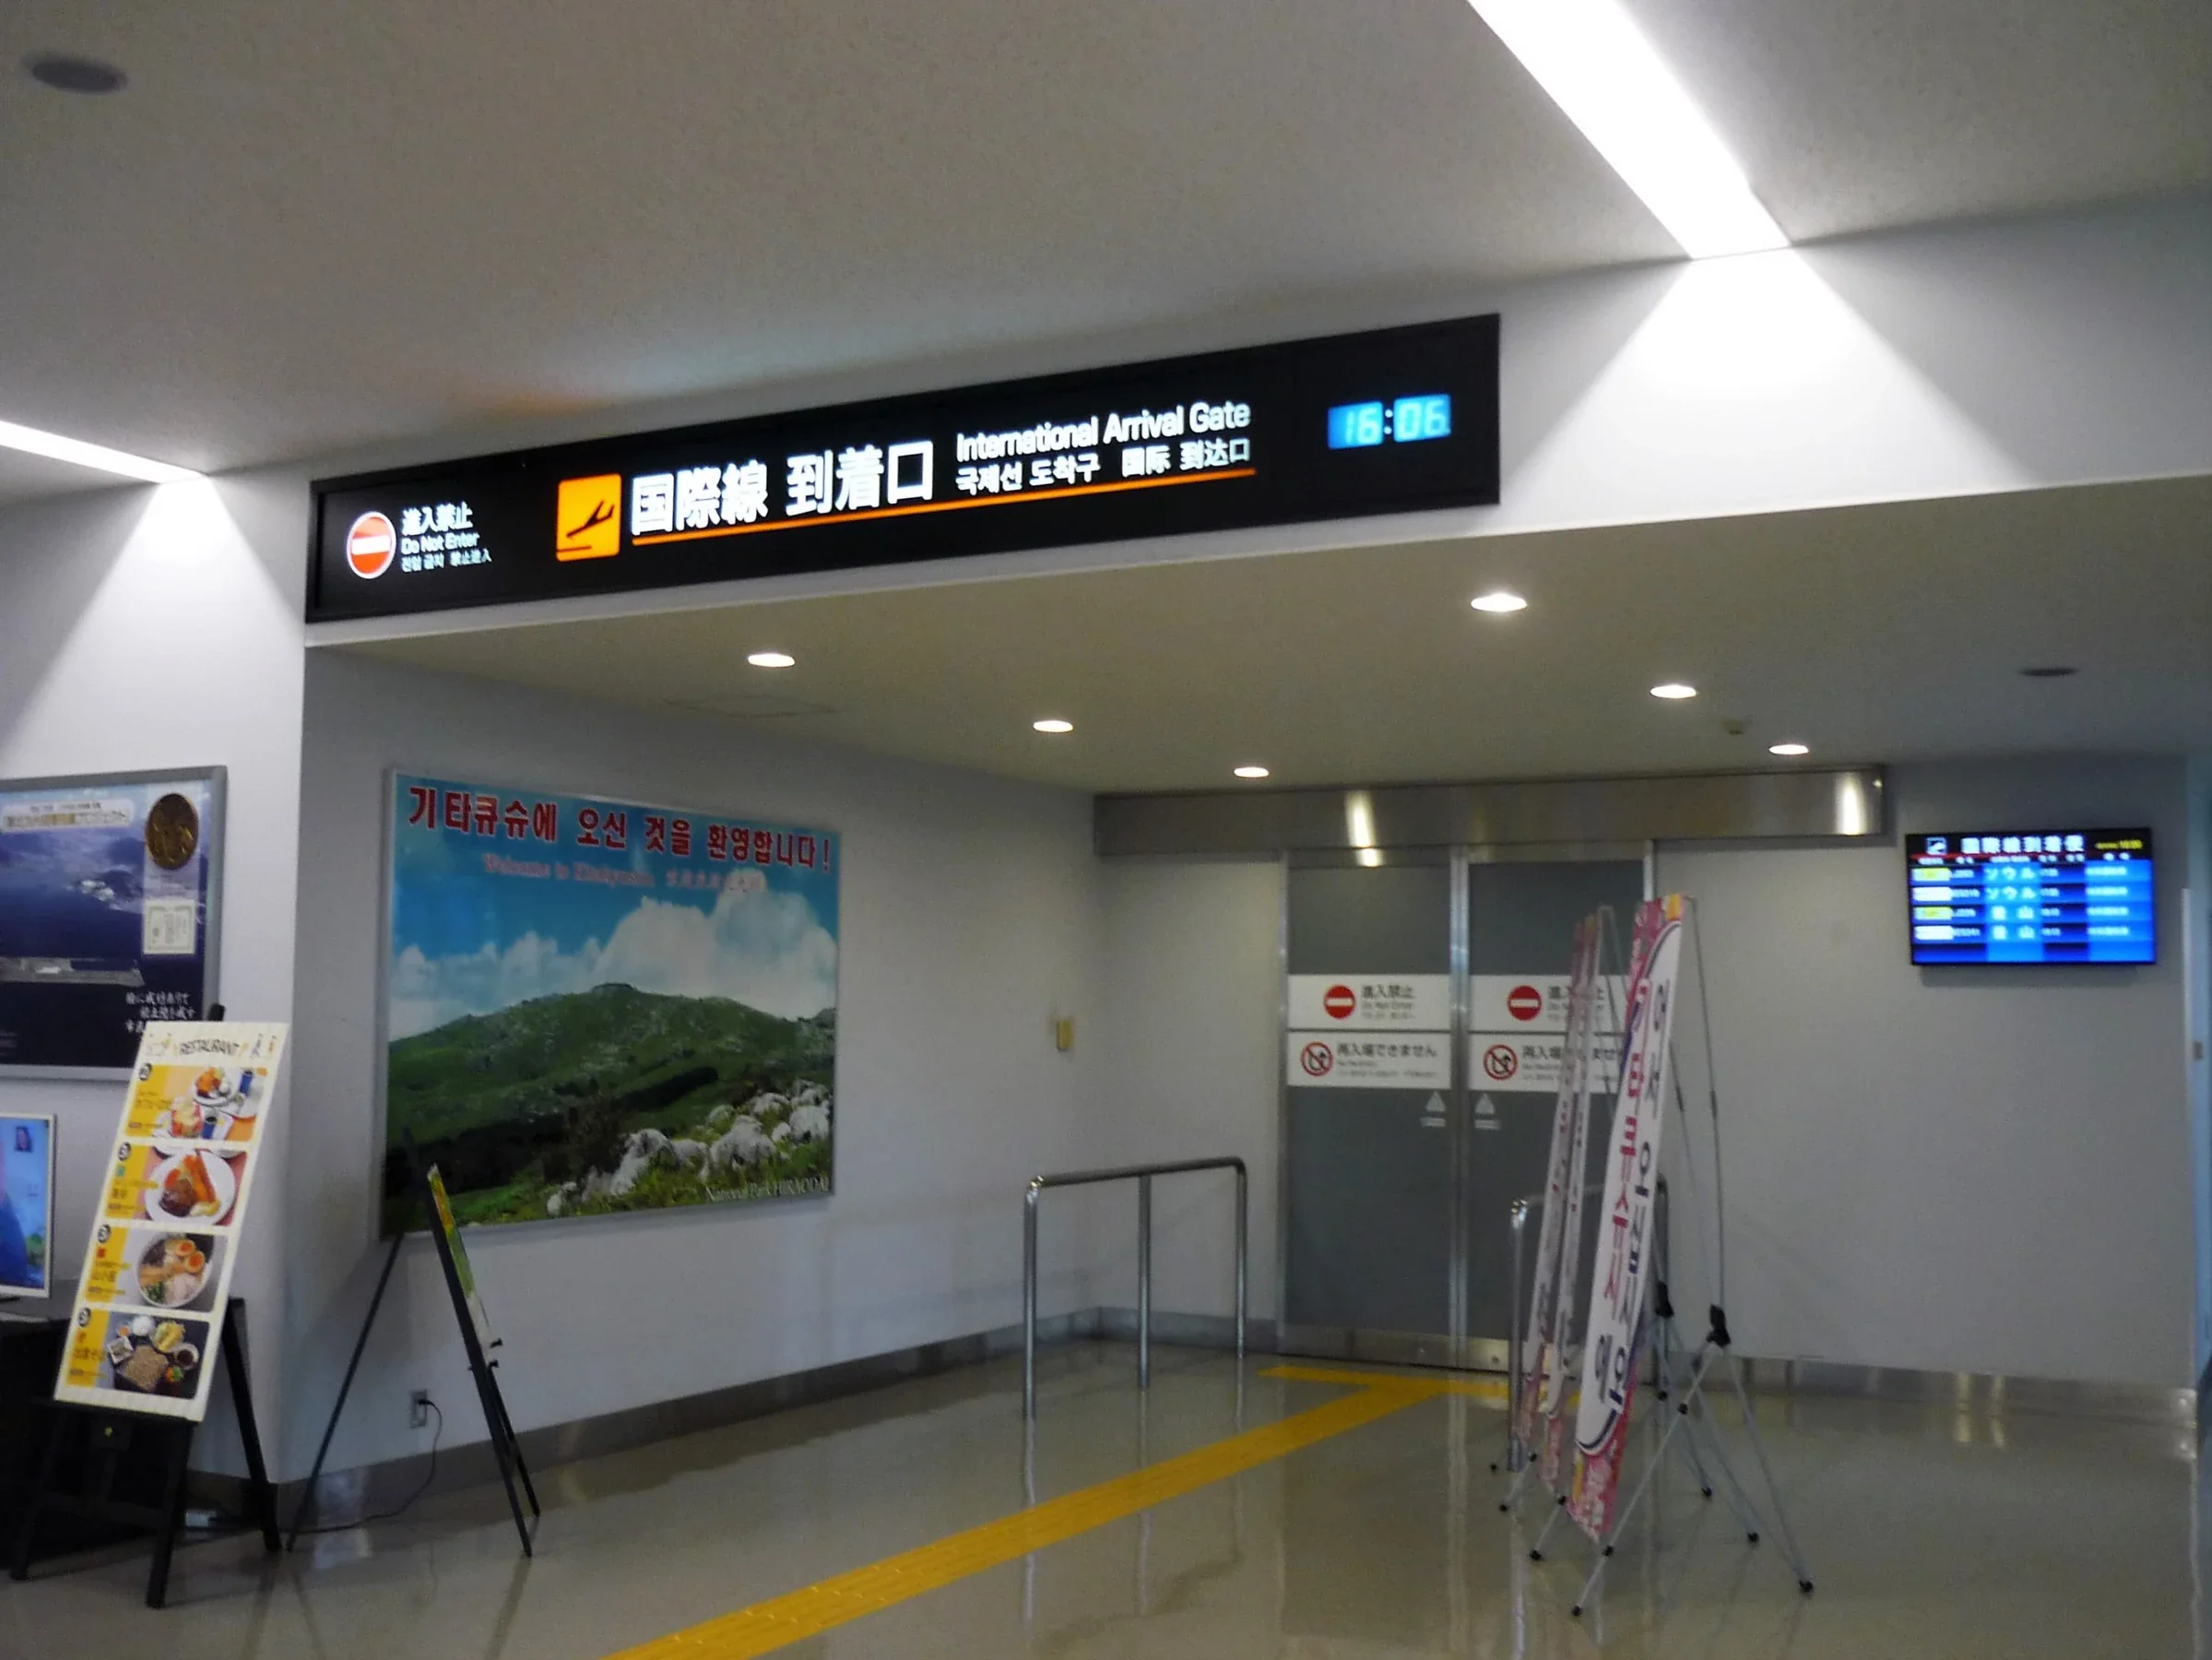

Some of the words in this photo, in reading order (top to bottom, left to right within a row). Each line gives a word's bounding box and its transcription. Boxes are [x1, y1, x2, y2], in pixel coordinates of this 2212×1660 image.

[956, 416, 1098, 462] International
[1103, 404, 1184, 444] Arrival
[1189, 401, 1251, 433] Gate
[1343, 396, 1450, 446] 16:06
[631, 459, 769, 536] 国際線
[785, 441, 934, 516] 到着口
[955, 461, 1023, 496] 국제선
[401, 537, 420, 555] Do
[420, 534, 444, 552] Not
[444, 531, 480, 550] Enter
[402, 501, 474, 536] 進入禁止
[408, 786, 557, 843] 기타큐슈에
[576, 808, 627, 850] 오신
[645, 816, 691, 857] 것을
